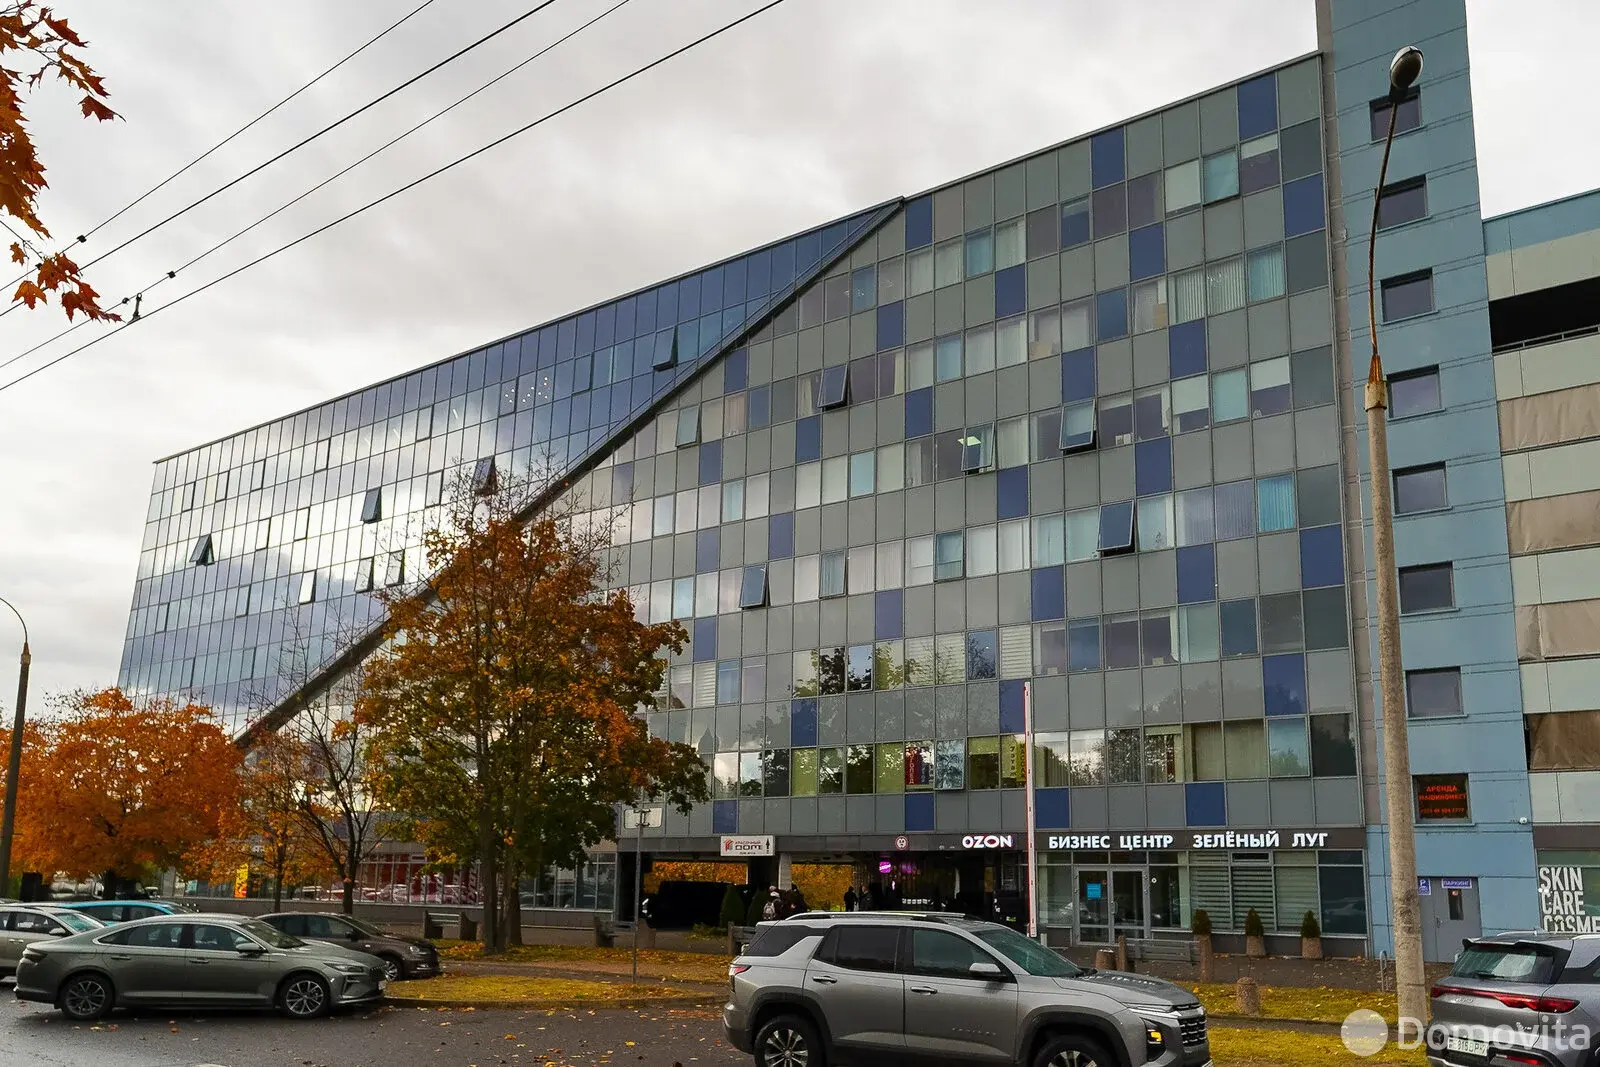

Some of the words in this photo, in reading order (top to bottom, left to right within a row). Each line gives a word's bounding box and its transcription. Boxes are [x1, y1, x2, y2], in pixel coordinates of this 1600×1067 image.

[962, 835, 1013, 849] OZON
[1048, 835, 1111, 849] БИЗНЕС
[1119, 834, 1174, 851] ЦЕНТР
[1192, 830, 1280, 848] ЗЕЛЁНЫЙ
[1292, 832, 1329, 848] ЛУГ
[1539, 866, 1584, 891] SKIN
[1541, 890, 1586, 915] CARE
